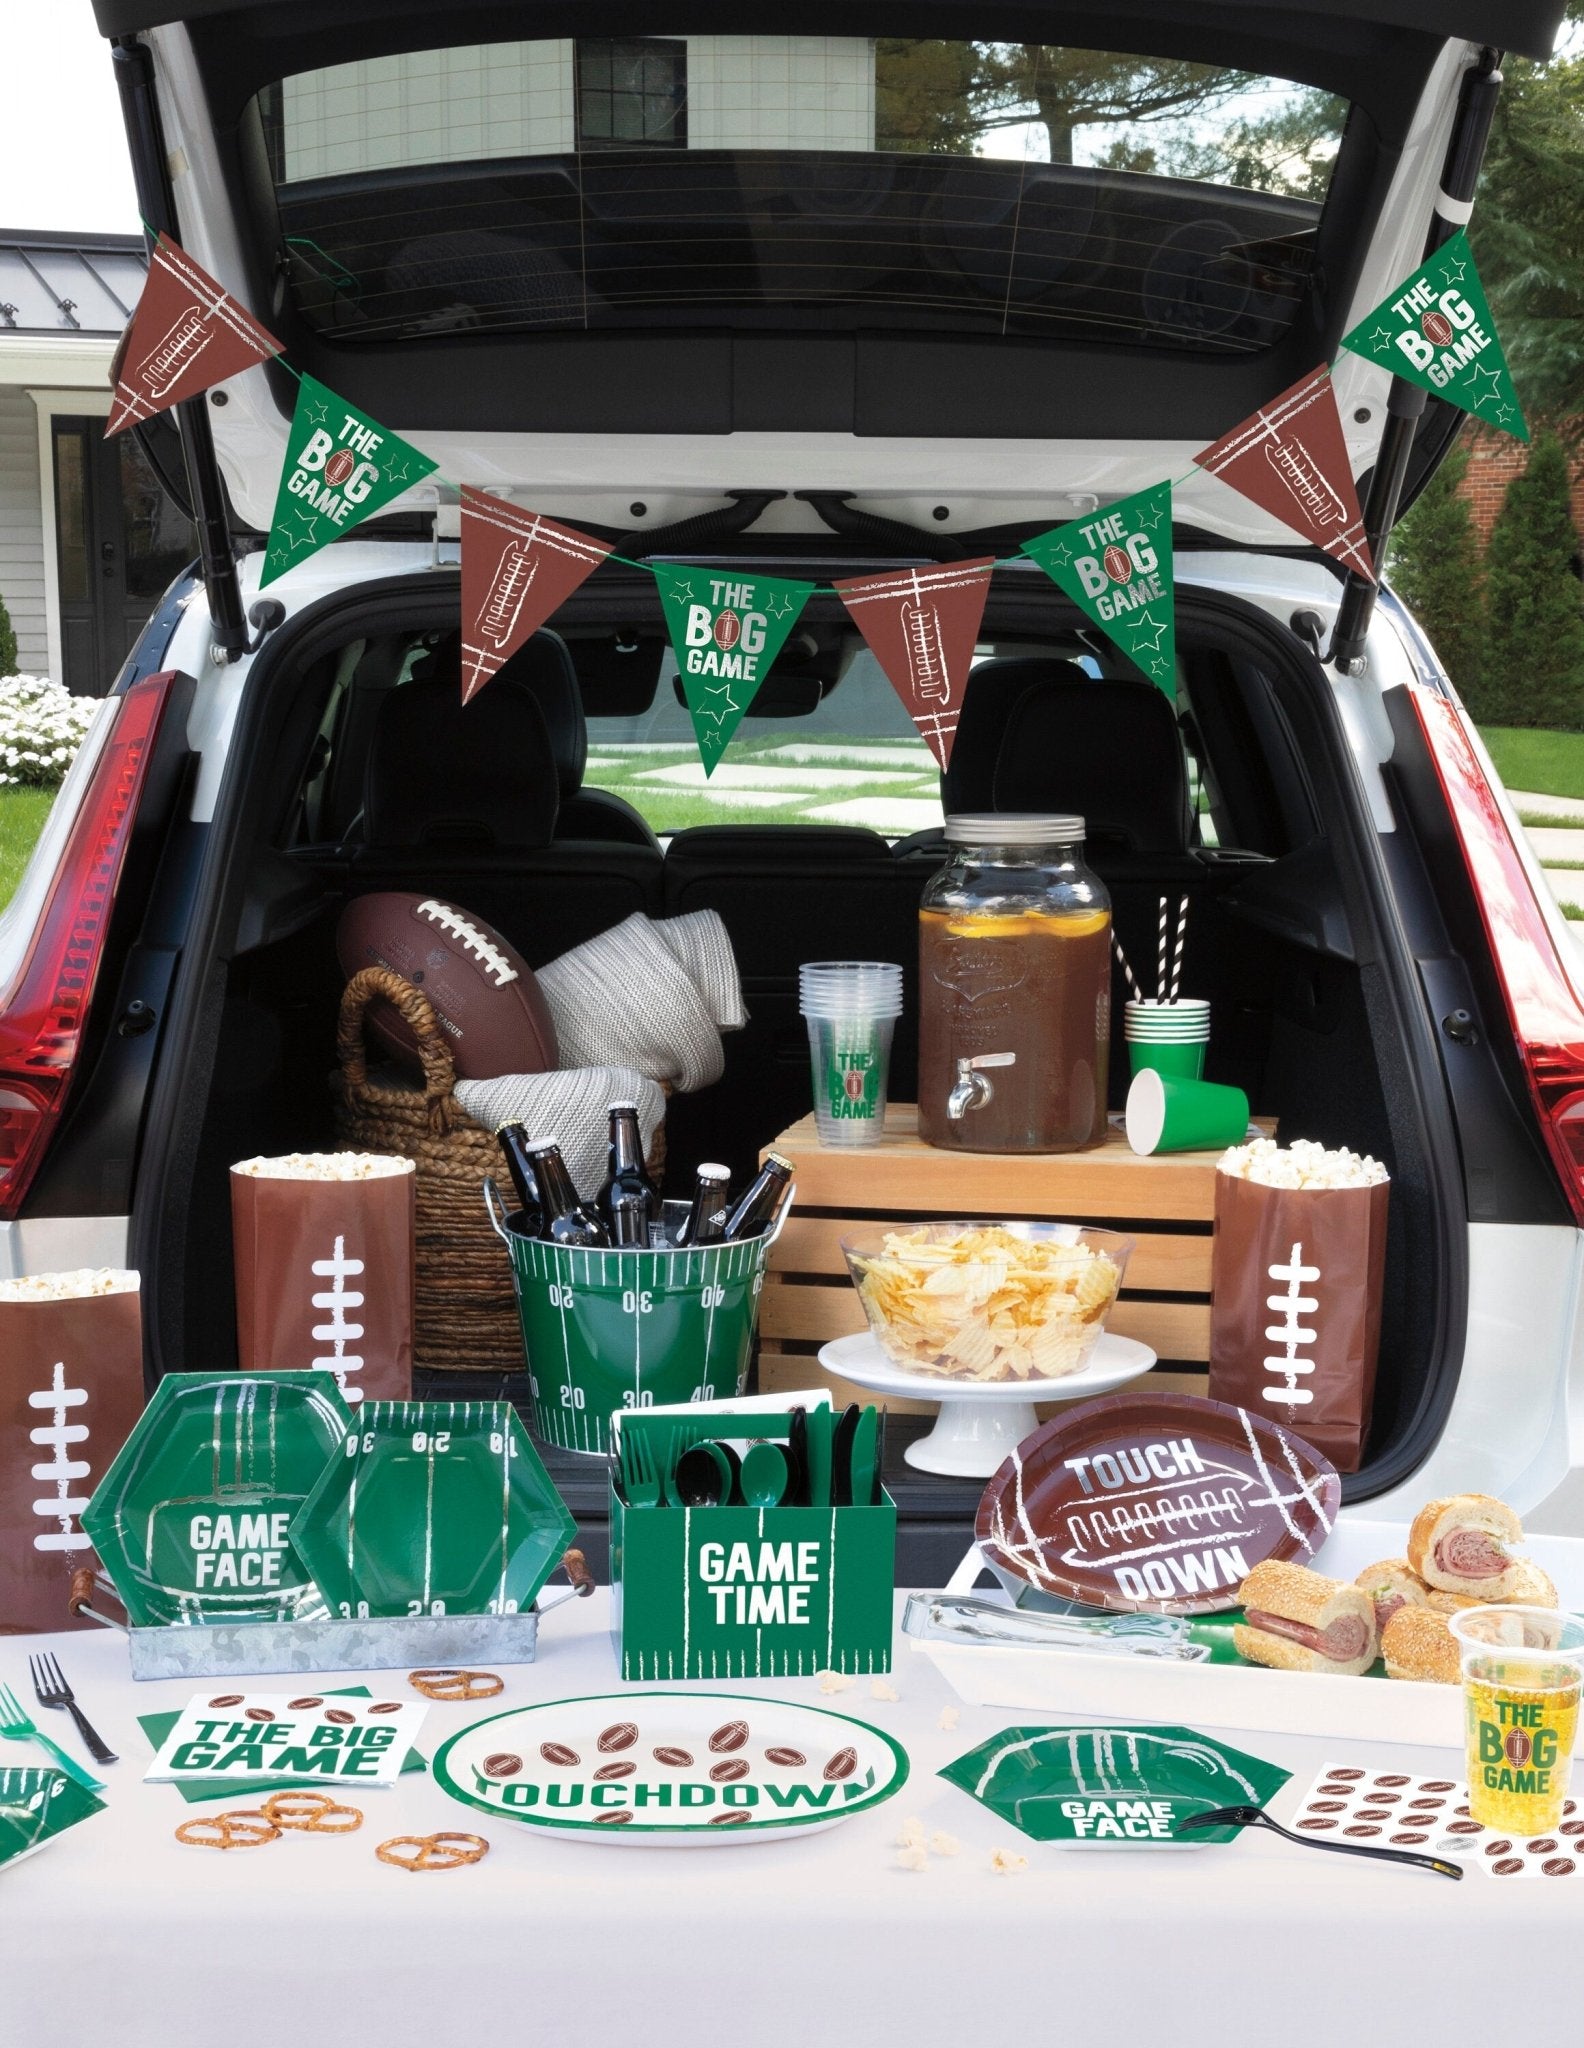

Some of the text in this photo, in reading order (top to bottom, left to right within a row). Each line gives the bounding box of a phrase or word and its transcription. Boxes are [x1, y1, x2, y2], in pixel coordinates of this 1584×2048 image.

[1390, 277, 1440, 324] THE
[1427, 322, 1492, 388] GAME
[338, 414, 384, 460] THE
[287, 469, 354, 526] GAME
[1078, 512, 1128, 550] THE
[710, 580, 756, 610] THE
[1096, 572, 1167, 621] GAME
[686, 649, 758, 681] GAME
[838, 1053, 871, 1071] THE
[831, 1101, 875, 1119] GAME
[549, 1284, 574, 1309] 20
[622, 1290, 653, 1313] 30
[701, 1284, 725, 1308] 40
[560, 1384, 585, 1409] 20
[622, 1390, 653, 1409] 30
[690, 1384, 715, 1403] 40
[346, 1432, 376, 1457] 30
[412, 1432, 451, 1453] 20
[1063, 1438, 1205, 1495] TOUCH
[190, 1513, 290, 1551] GAME
[196, 1551, 281, 1588] FACE
[699, 1542, 820, 1582] GAME
[1113, 1545, 1250, 1602] DOWN
[339, 1600, 370, 1619] 30
[407, 1600, 445, 1617] 20
[707, 1585, 810, 1625] TIME
[1495, 1700, 1544, 1727] THE
[194, 1720, 398, 1747] THE BIG
[168, 1742, 390, 1776] GAME
[471, 1763, 876, 1807] TOUCHDOWN
[1483, 1769, 1551, 1794] GAME
[1060, 1801, 1176, 1819] GAME
[1072, 1818, 1174, 1838] FACE
